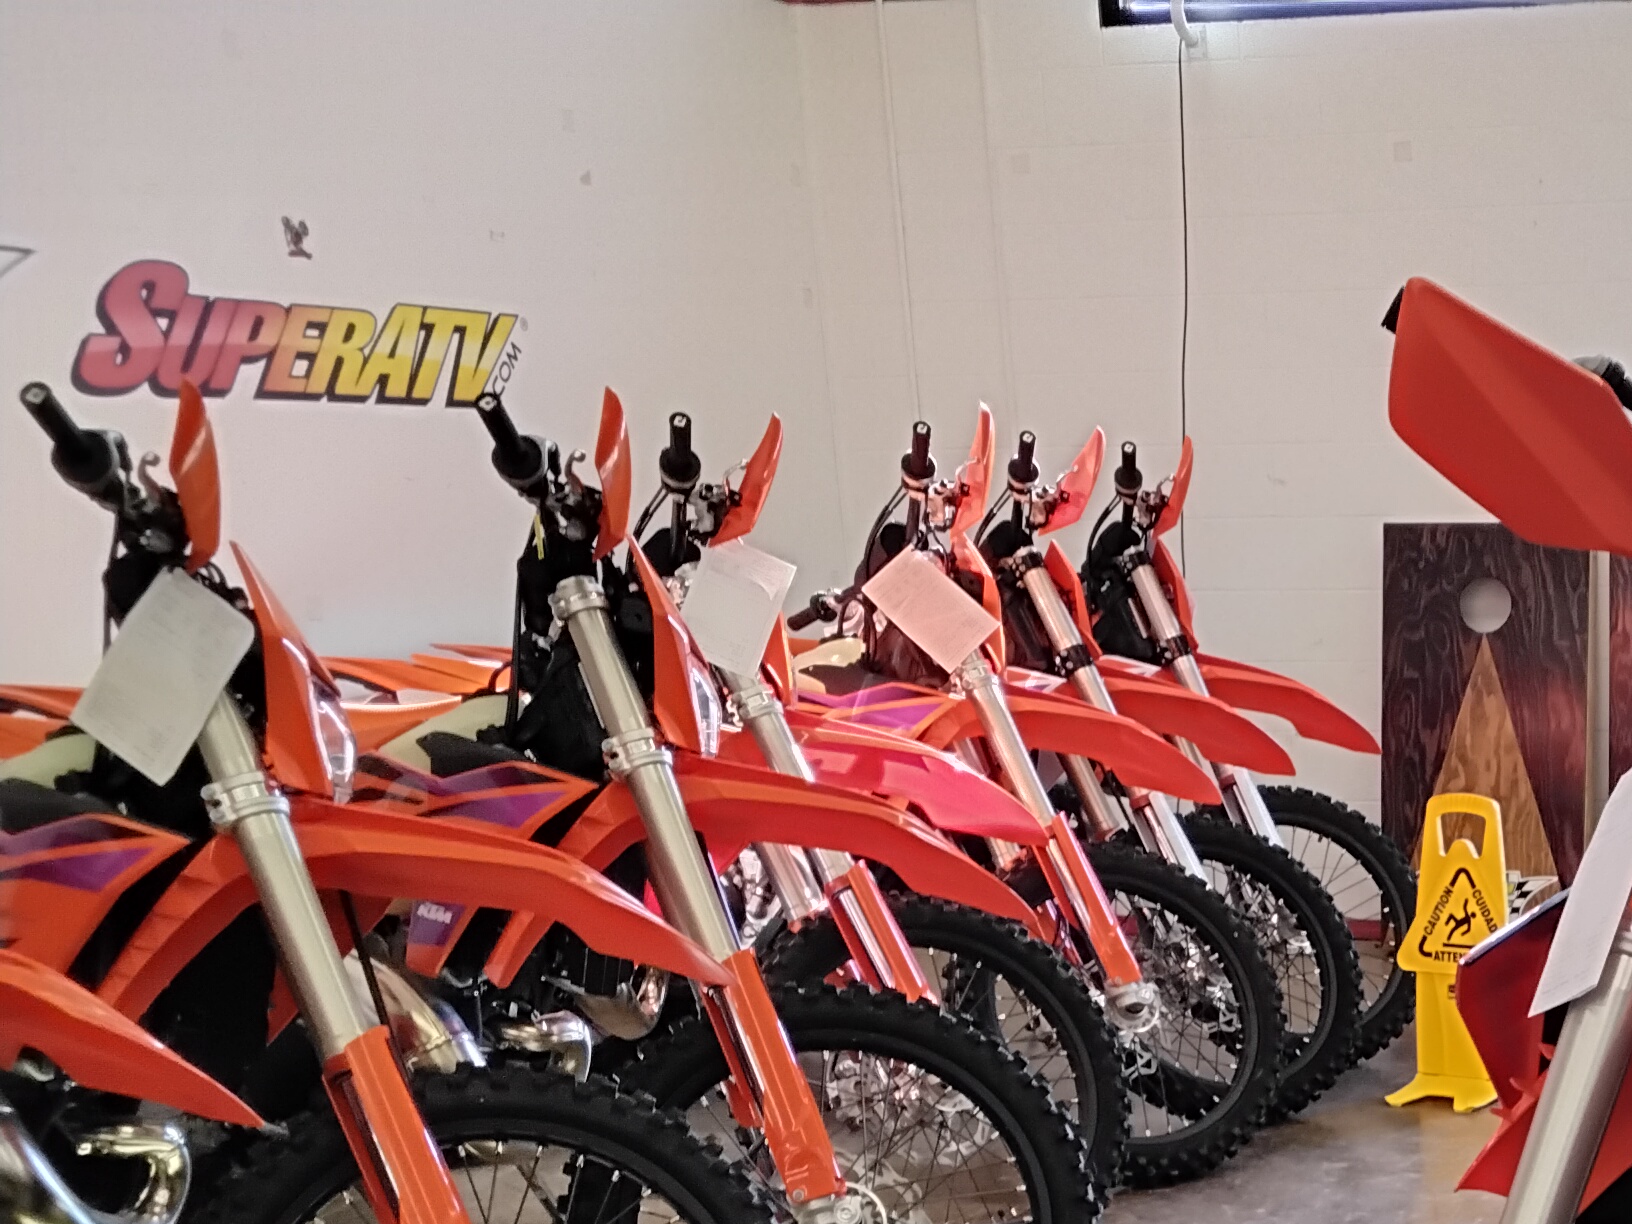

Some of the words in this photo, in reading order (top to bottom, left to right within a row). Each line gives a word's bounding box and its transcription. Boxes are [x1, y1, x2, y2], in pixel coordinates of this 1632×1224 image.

[71, 259, 518, 407] SUPERATV
[1423, 885, 1454, 936] CAUTION
[1472, 888, 1498, 934] CUIDAD
